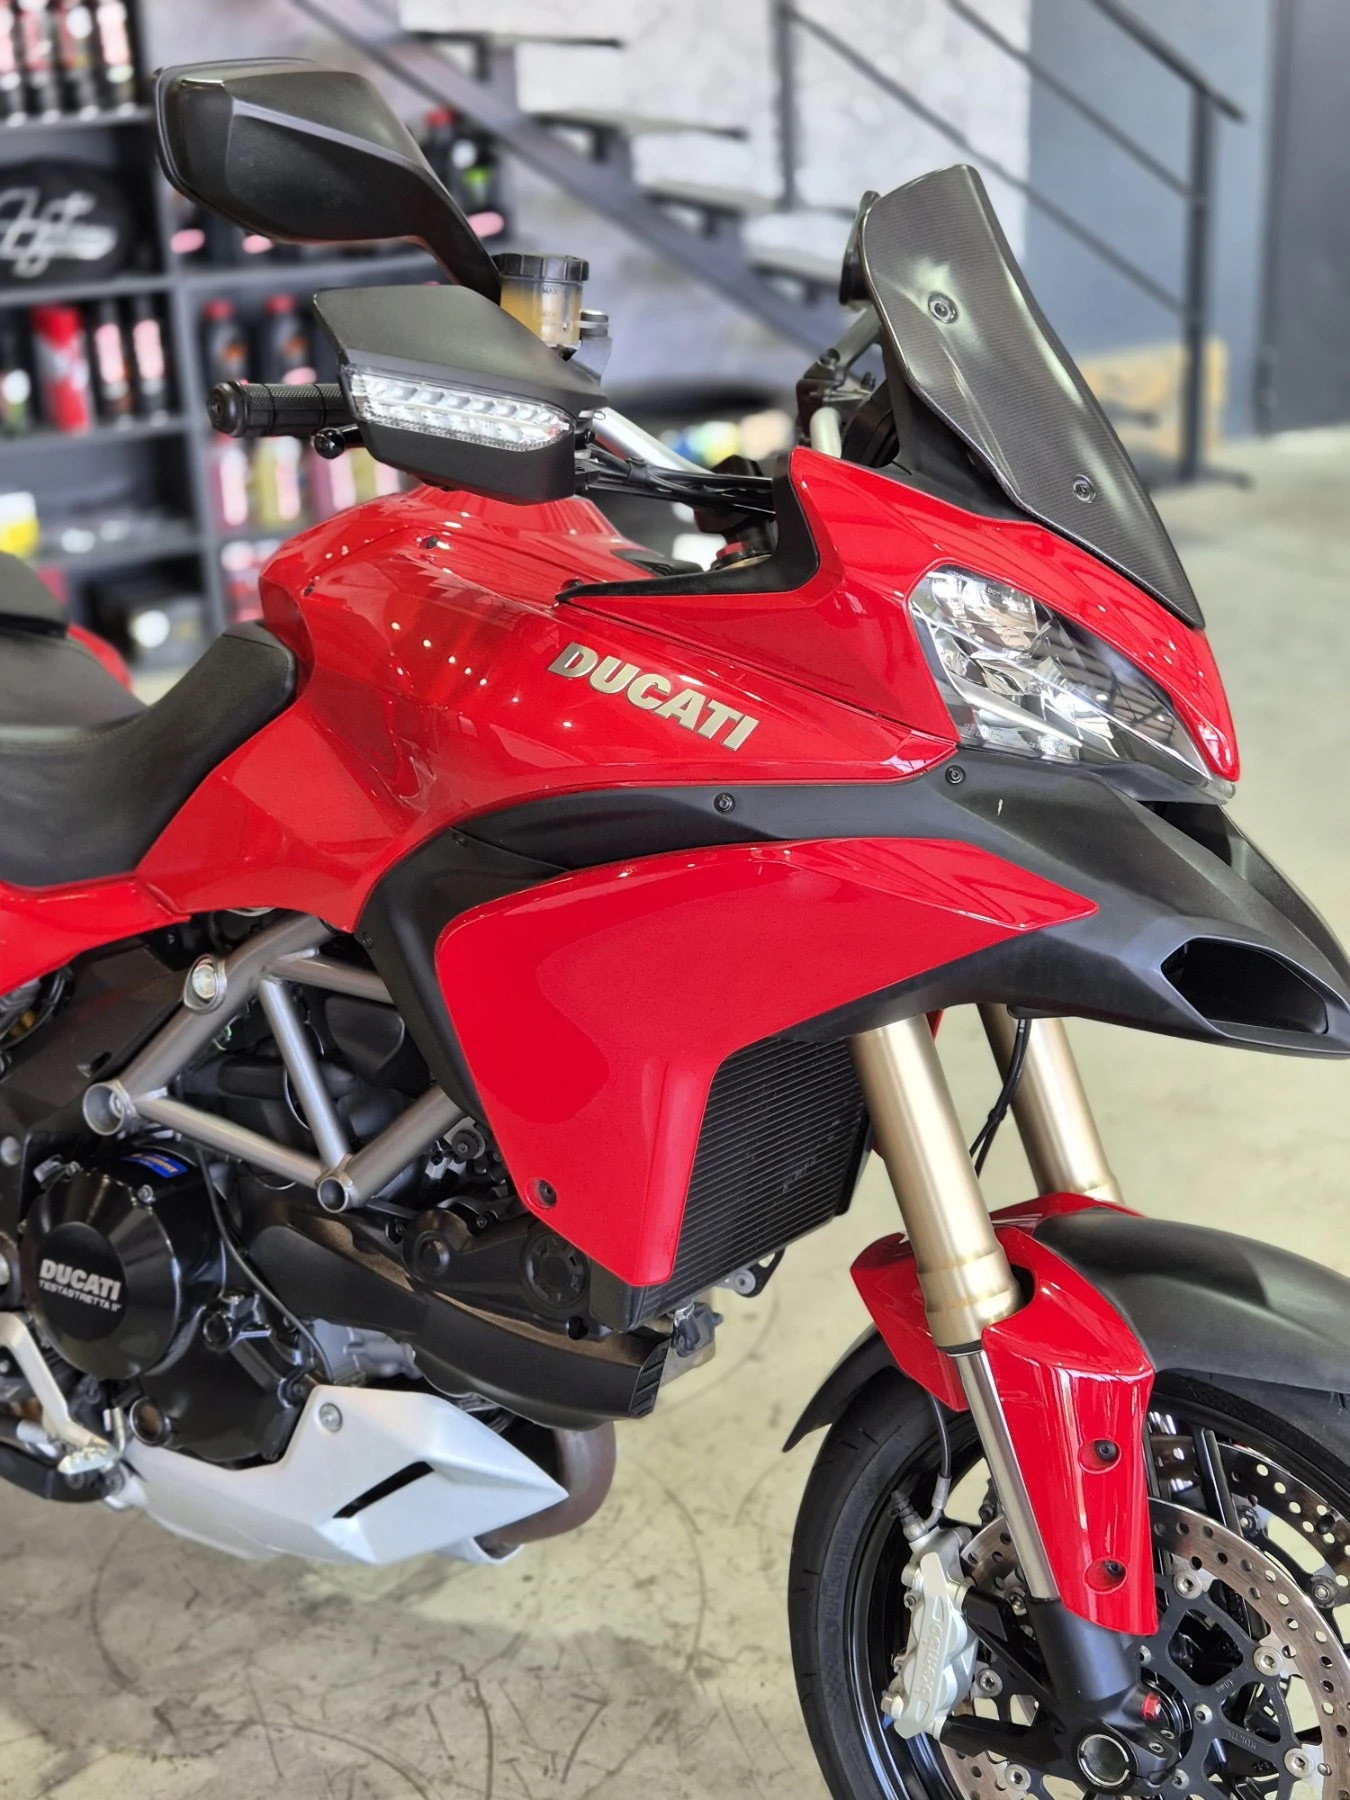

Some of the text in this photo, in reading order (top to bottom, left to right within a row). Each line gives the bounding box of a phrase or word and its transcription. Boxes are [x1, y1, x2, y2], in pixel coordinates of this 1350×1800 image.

[547, 641, 760, 752] DUCATI
[39, 1258, 122, 1302] DUCATI
[39, 1279, 110, 1310] TESTASTRETTA
[914, 1621, 943, 1700] brembo
